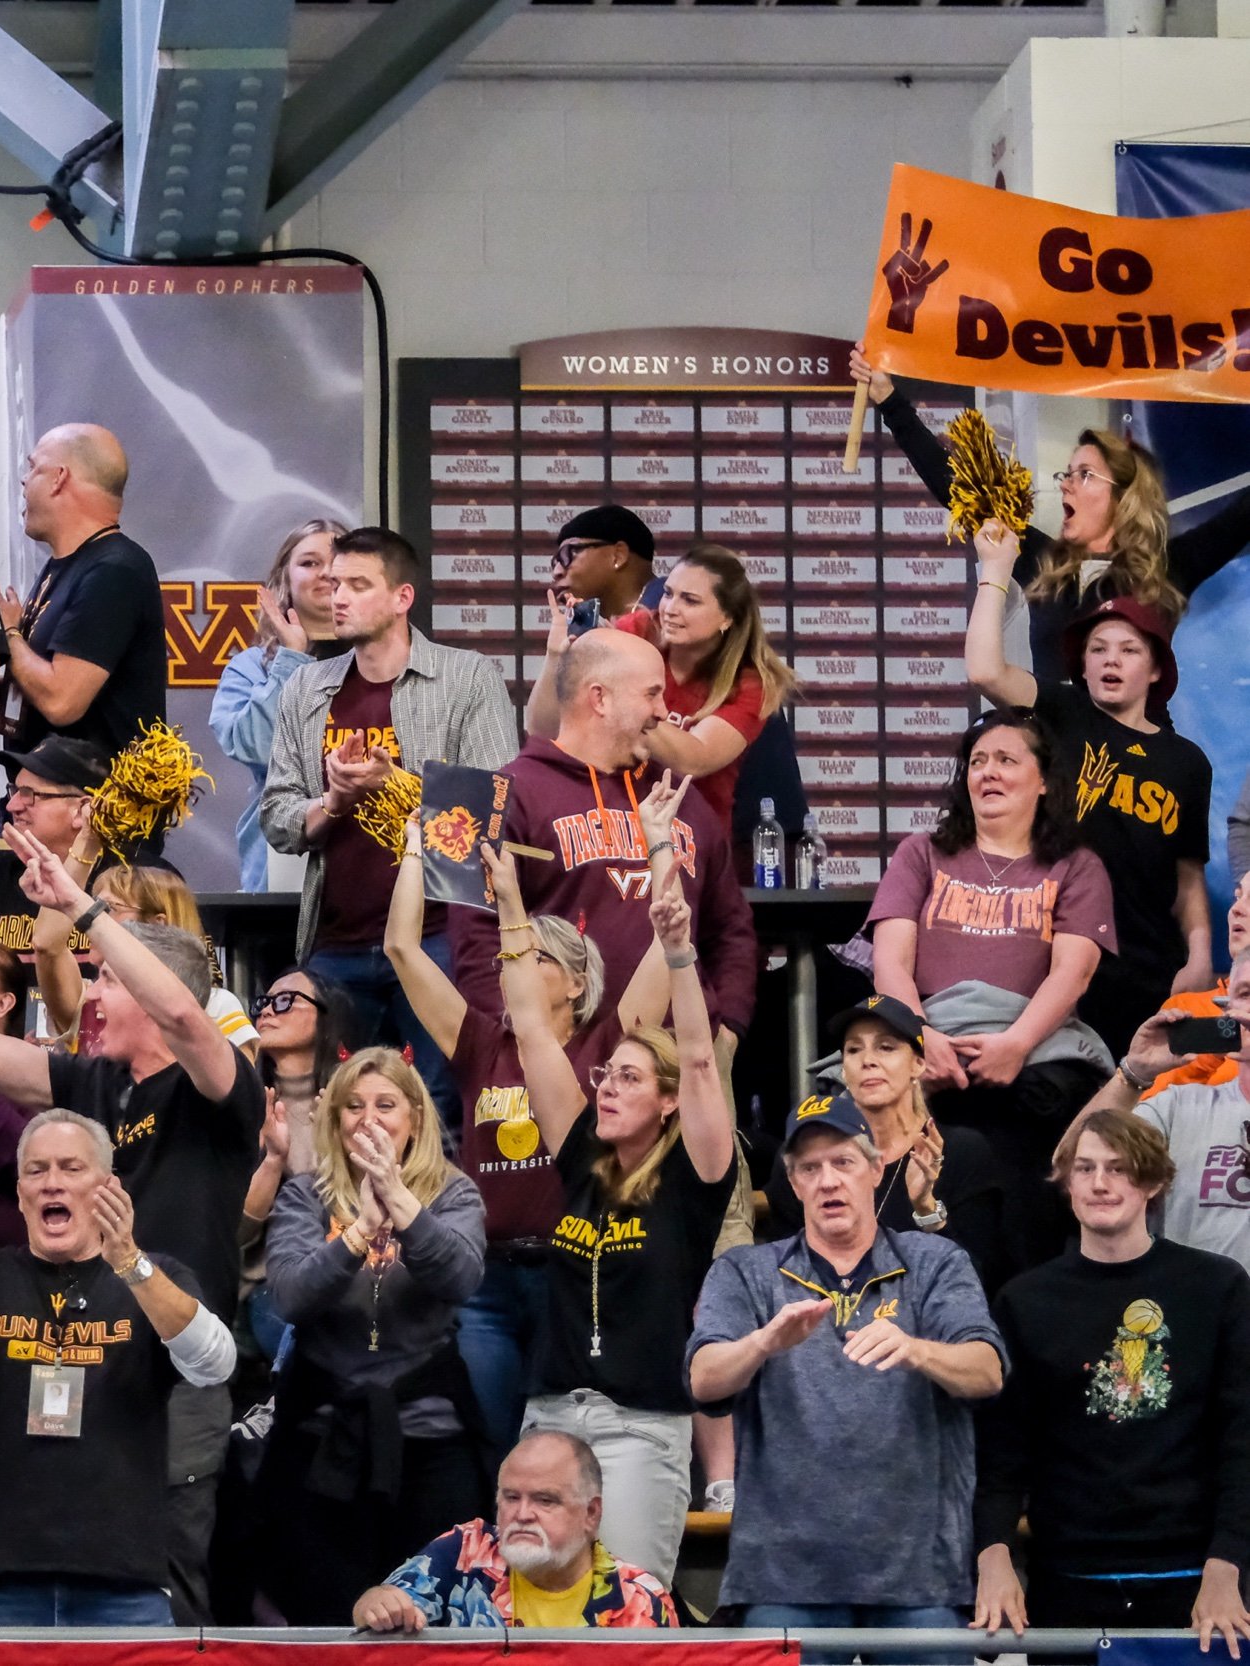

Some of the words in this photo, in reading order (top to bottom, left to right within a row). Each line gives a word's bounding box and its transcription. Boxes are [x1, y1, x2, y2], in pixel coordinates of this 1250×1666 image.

[1039, 226, 1153, 296] Go
[74, 279, 175, 295] GOLDEN
[196, 279, 314, 295] GOPHERS
[955, 294, 1250, 372] Devils!
[562, 355, 698, 375] WOMEN'S
[711, 356, 831, 375] HONORS
[1108, 774, 1181, 836] ASU
[762, 847, 774, 888] smart
[796, 1094, 834, 1120] Cal
[479, 1155, 552, 1173] UNIVERSIT
[554, 1215, 599, 1247] SUN
[601, 1216, 647, 1244] EVIL
[605, 1241, 643, 1254] DIVING
